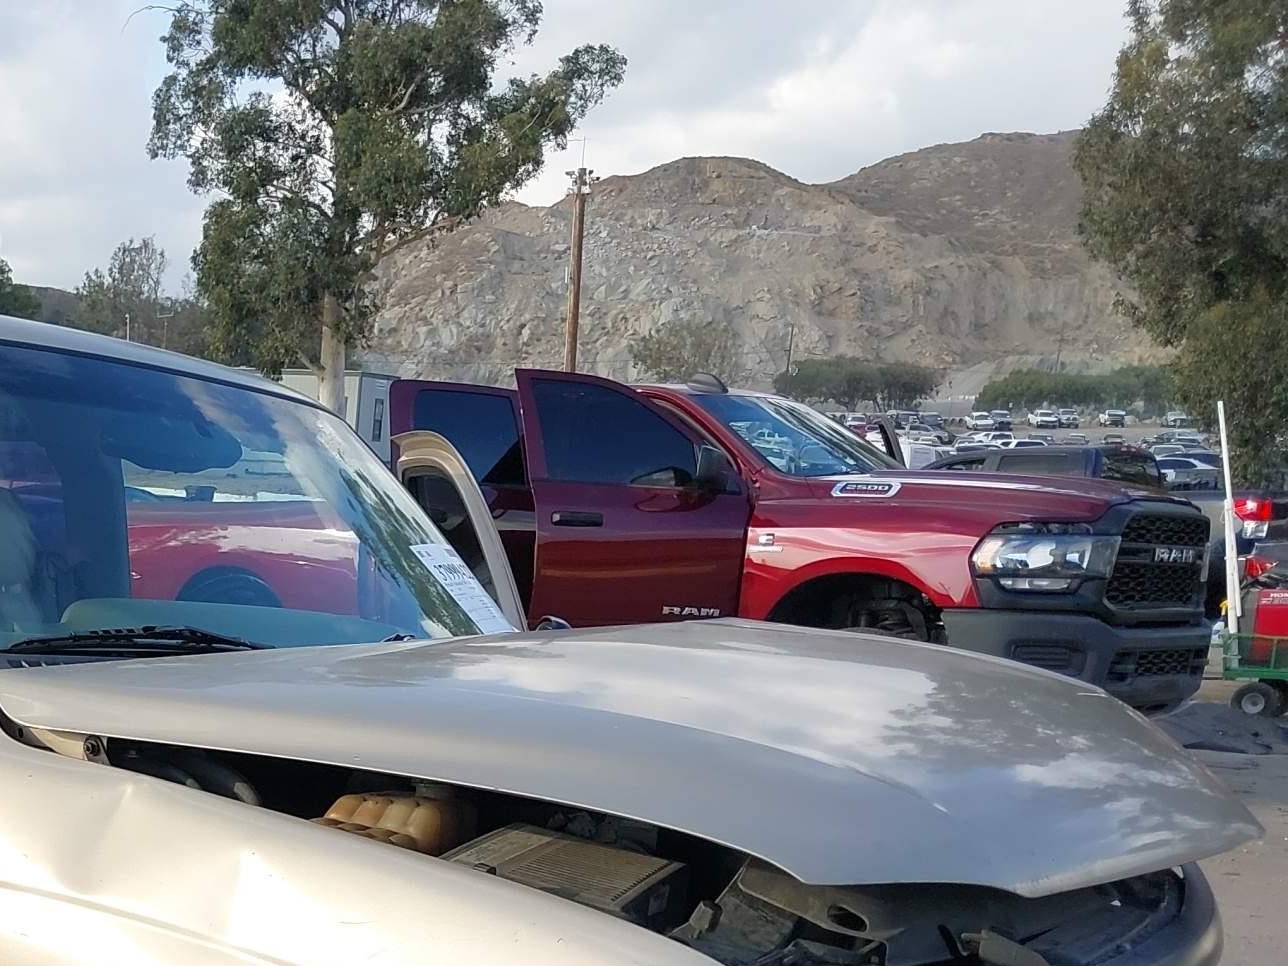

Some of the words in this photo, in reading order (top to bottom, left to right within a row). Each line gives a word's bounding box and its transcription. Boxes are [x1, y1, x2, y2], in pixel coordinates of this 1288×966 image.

[845, 483, 889, 492] 2500
[1154, 547, 1194, 562] RAM
[662, 605, 721, 617] RAM
